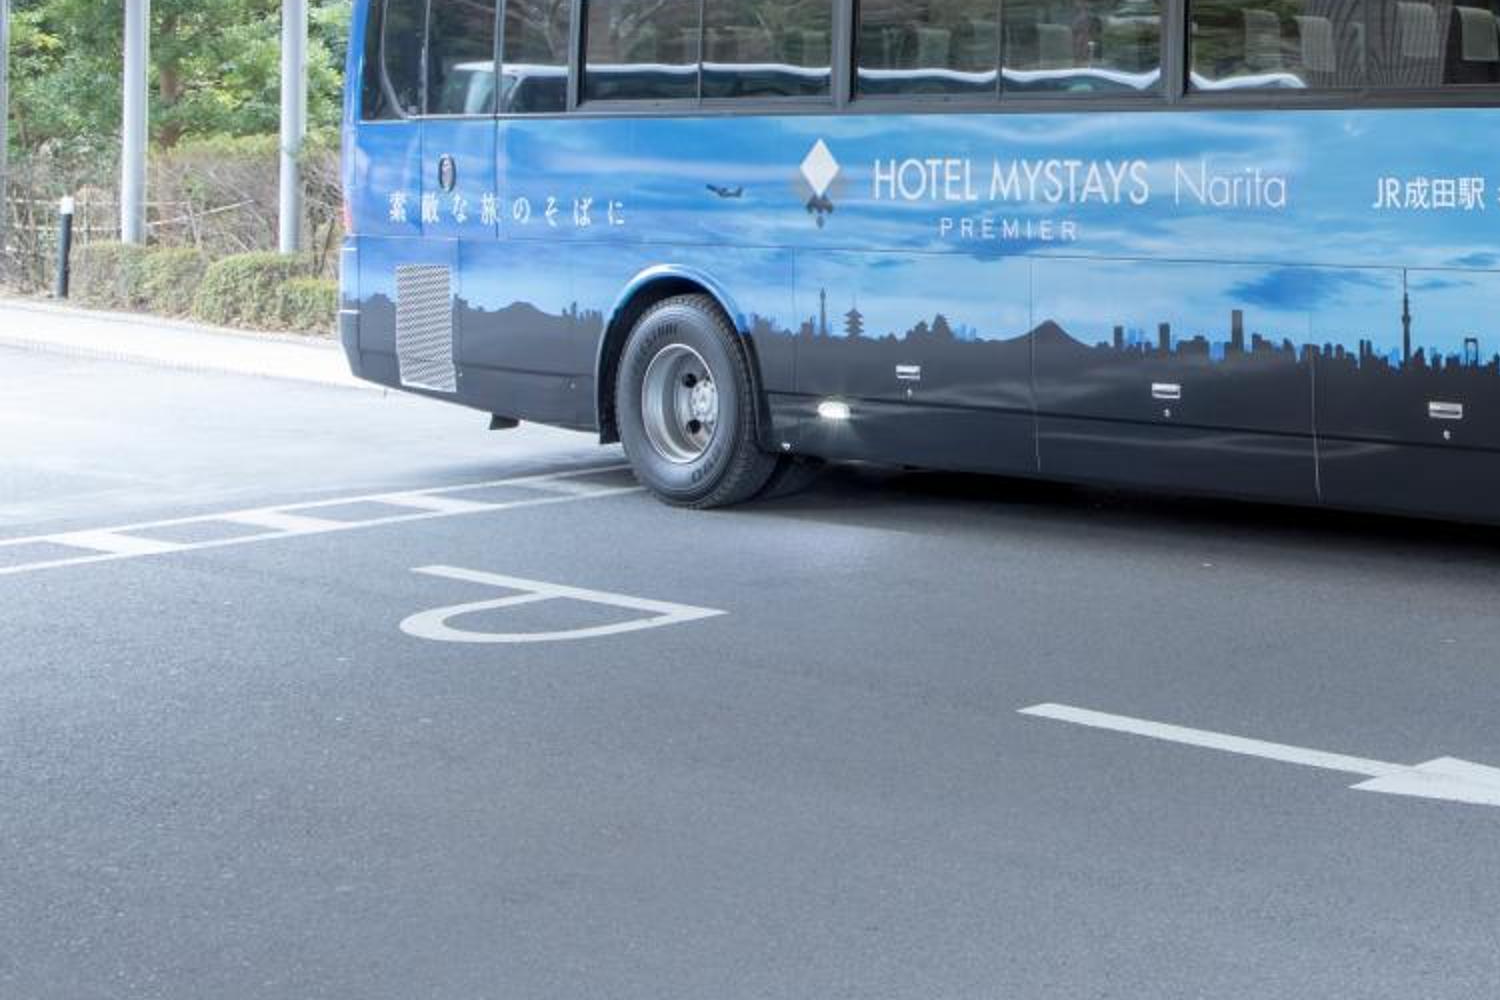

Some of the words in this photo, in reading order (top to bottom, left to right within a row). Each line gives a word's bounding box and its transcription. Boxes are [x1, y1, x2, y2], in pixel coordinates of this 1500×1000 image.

[873, 158, 979, 201] HOTEL
[989, 159, 1149, 205] MYSTAYS
[1173, 161, 1287, 208] Narita
[1372, 175, 1486, 211] JR成田駅
[938, 216, 1080, 241] PREMIER
